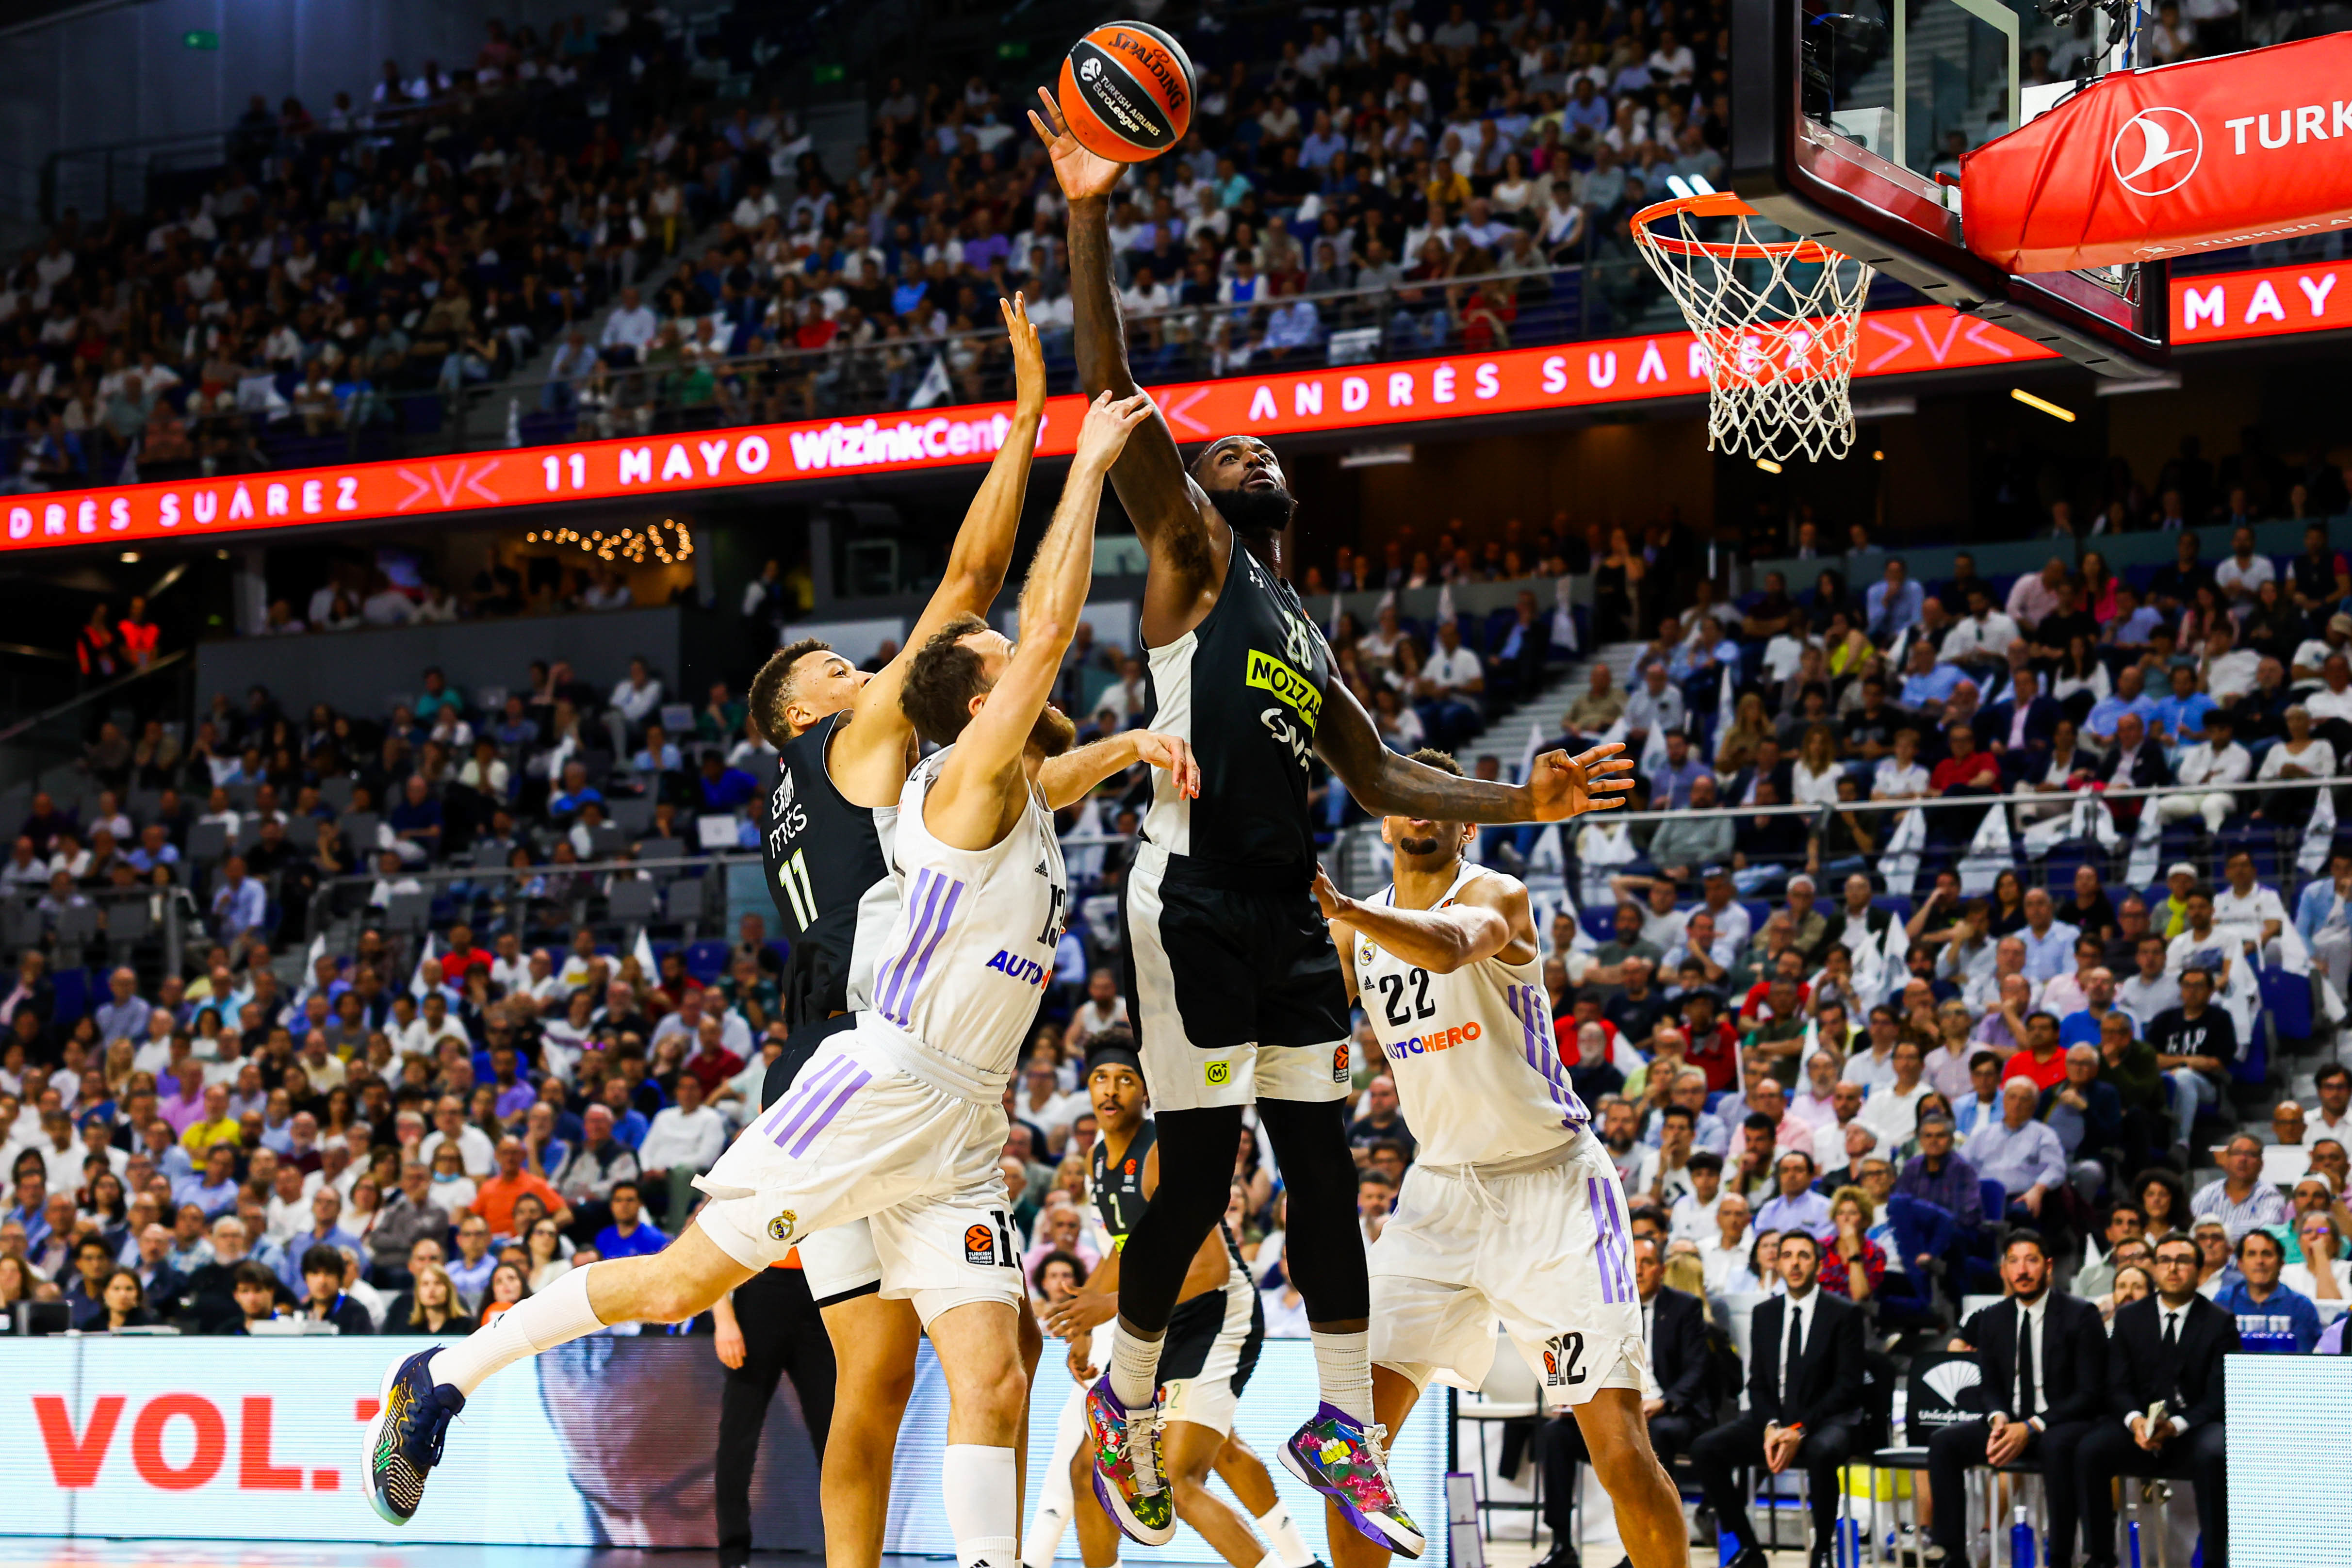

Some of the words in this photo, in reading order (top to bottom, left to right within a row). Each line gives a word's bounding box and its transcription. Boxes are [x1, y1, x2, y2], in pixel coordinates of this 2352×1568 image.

[1108, 32, 1185, 111] SPALDING
[1092, 81, 1140, 133] EuroLeague
[1100, 75, 1132, 110] TURKISH
[1129, 108, 1160, 136] AIRLINES
[2225, 100, 2352, 156] TURK
[2193, 223, 2320, 247] TURKISH
[2330, 216, 2352, 225] A
[2184, 273, 2337, 331] MAY
[542, 452, 586, 492] 11
[619, 434, 770, 486] MAYO
[769, 803, 807, 859] mts
[779, 847, 819, 933] 11
[1037, 883, 1065, 948] 13
[1379, 967, 1436, 1027] 22
[31, 1393, 341, 1491] VOL.
